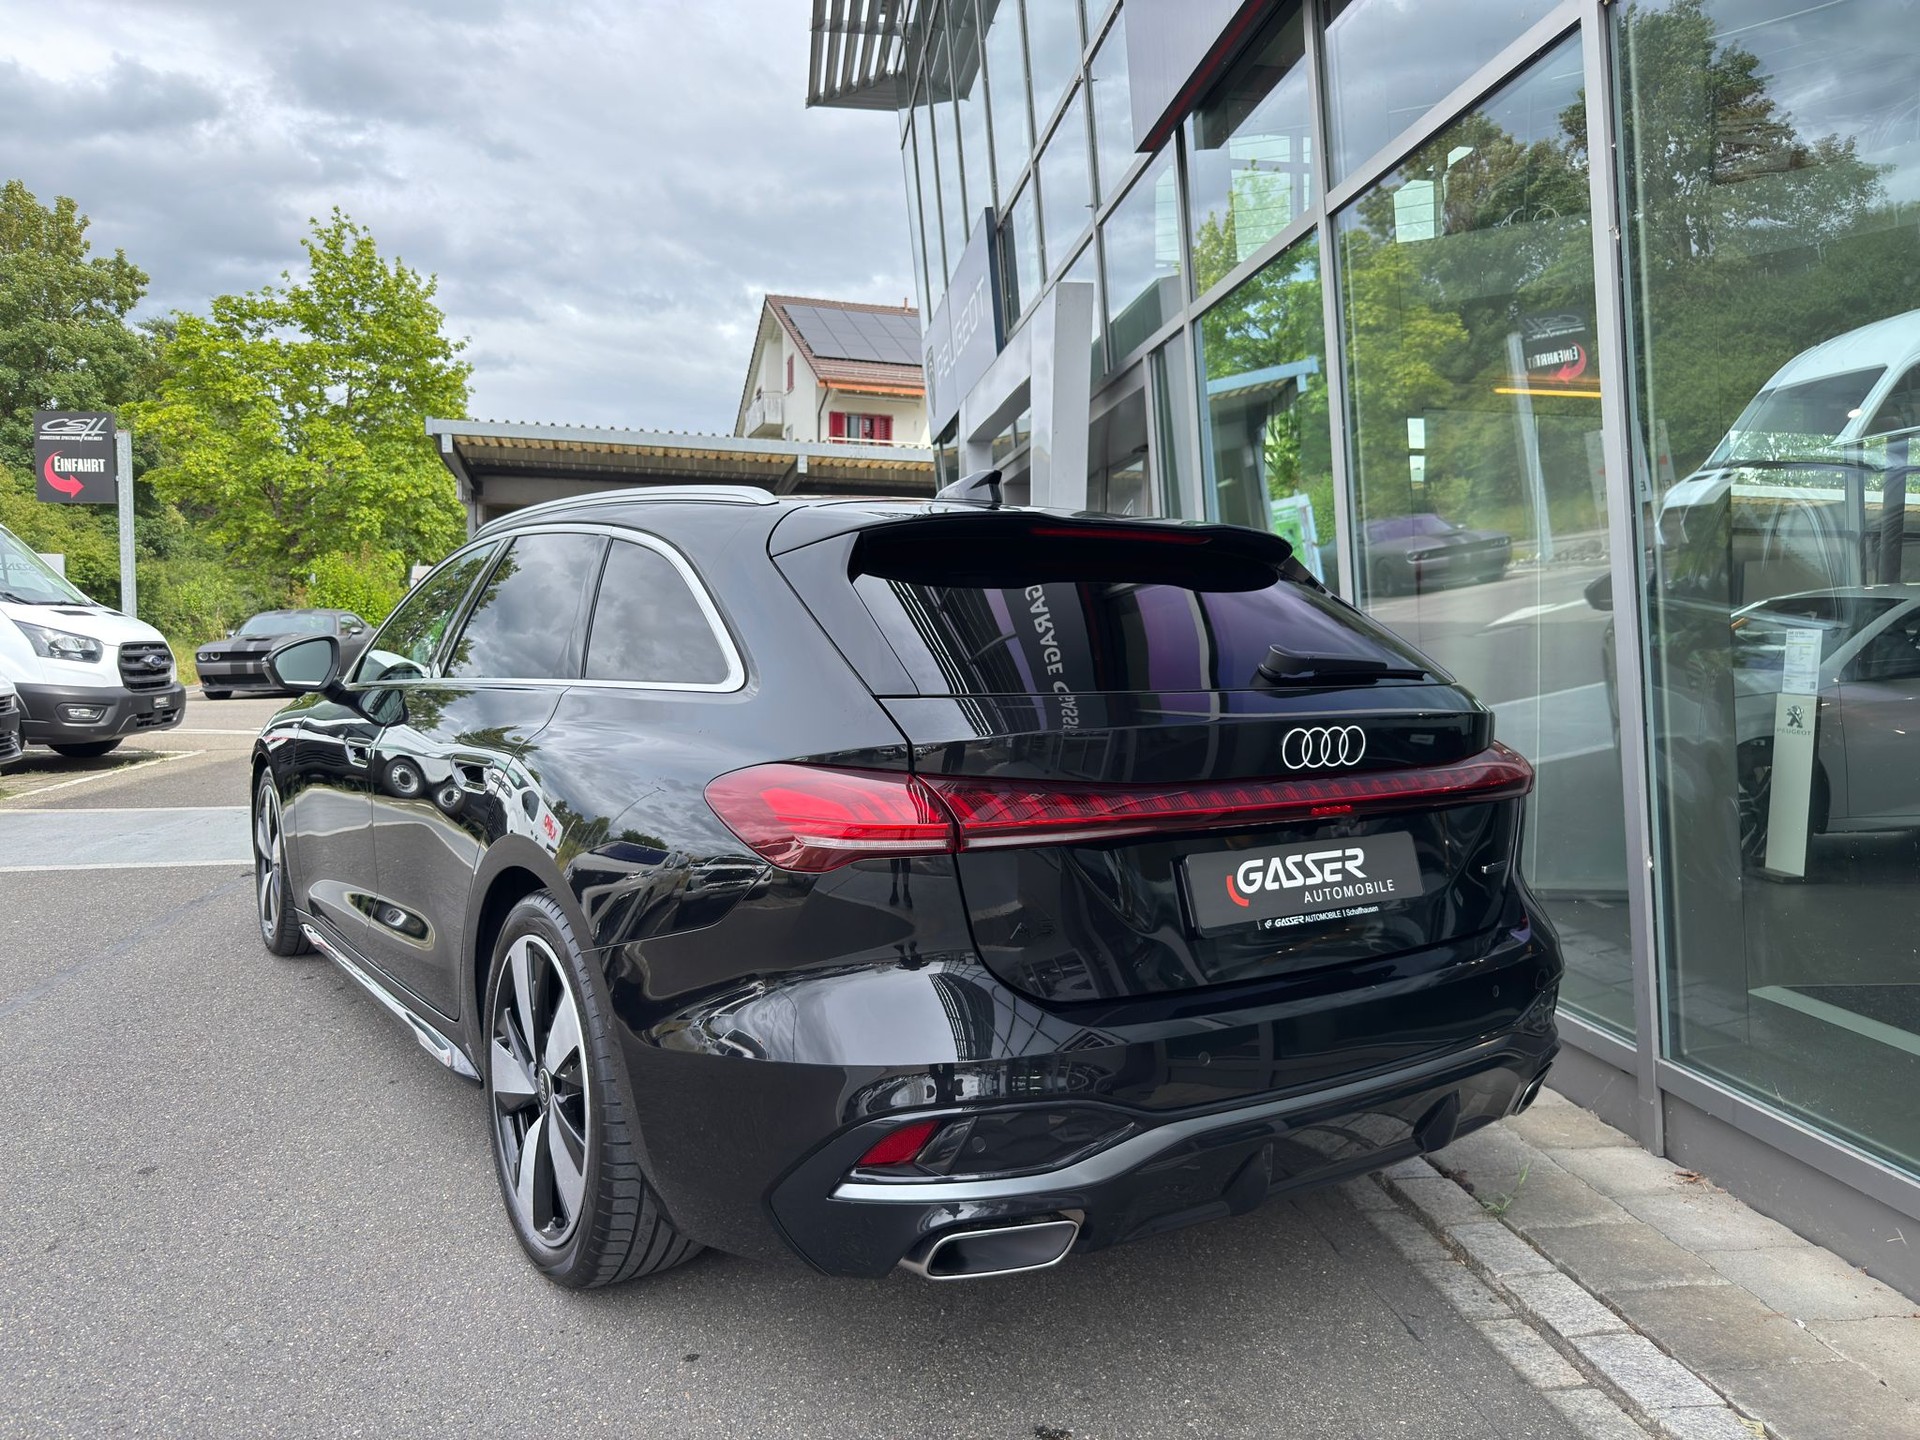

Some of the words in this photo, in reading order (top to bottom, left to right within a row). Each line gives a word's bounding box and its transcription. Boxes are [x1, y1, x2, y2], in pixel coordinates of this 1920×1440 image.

[936, 274, 985, 386] PEUGEOT
[40, 417, 108, 442] CSH
[53, 455, 106, 473] EINFAHRT
[1776, 727, 1812, 737] PEUGEOT
[1236, 847, 1367, 894] GASSER
[1303, 878, 1396, 904] AUTOMOBILE
[1274, 915, 1305, 927] GASSER
[1305, 909, 1342, 923] AUTOMOBILE
[1346, 905, 1379, 917] Schaffhausen
